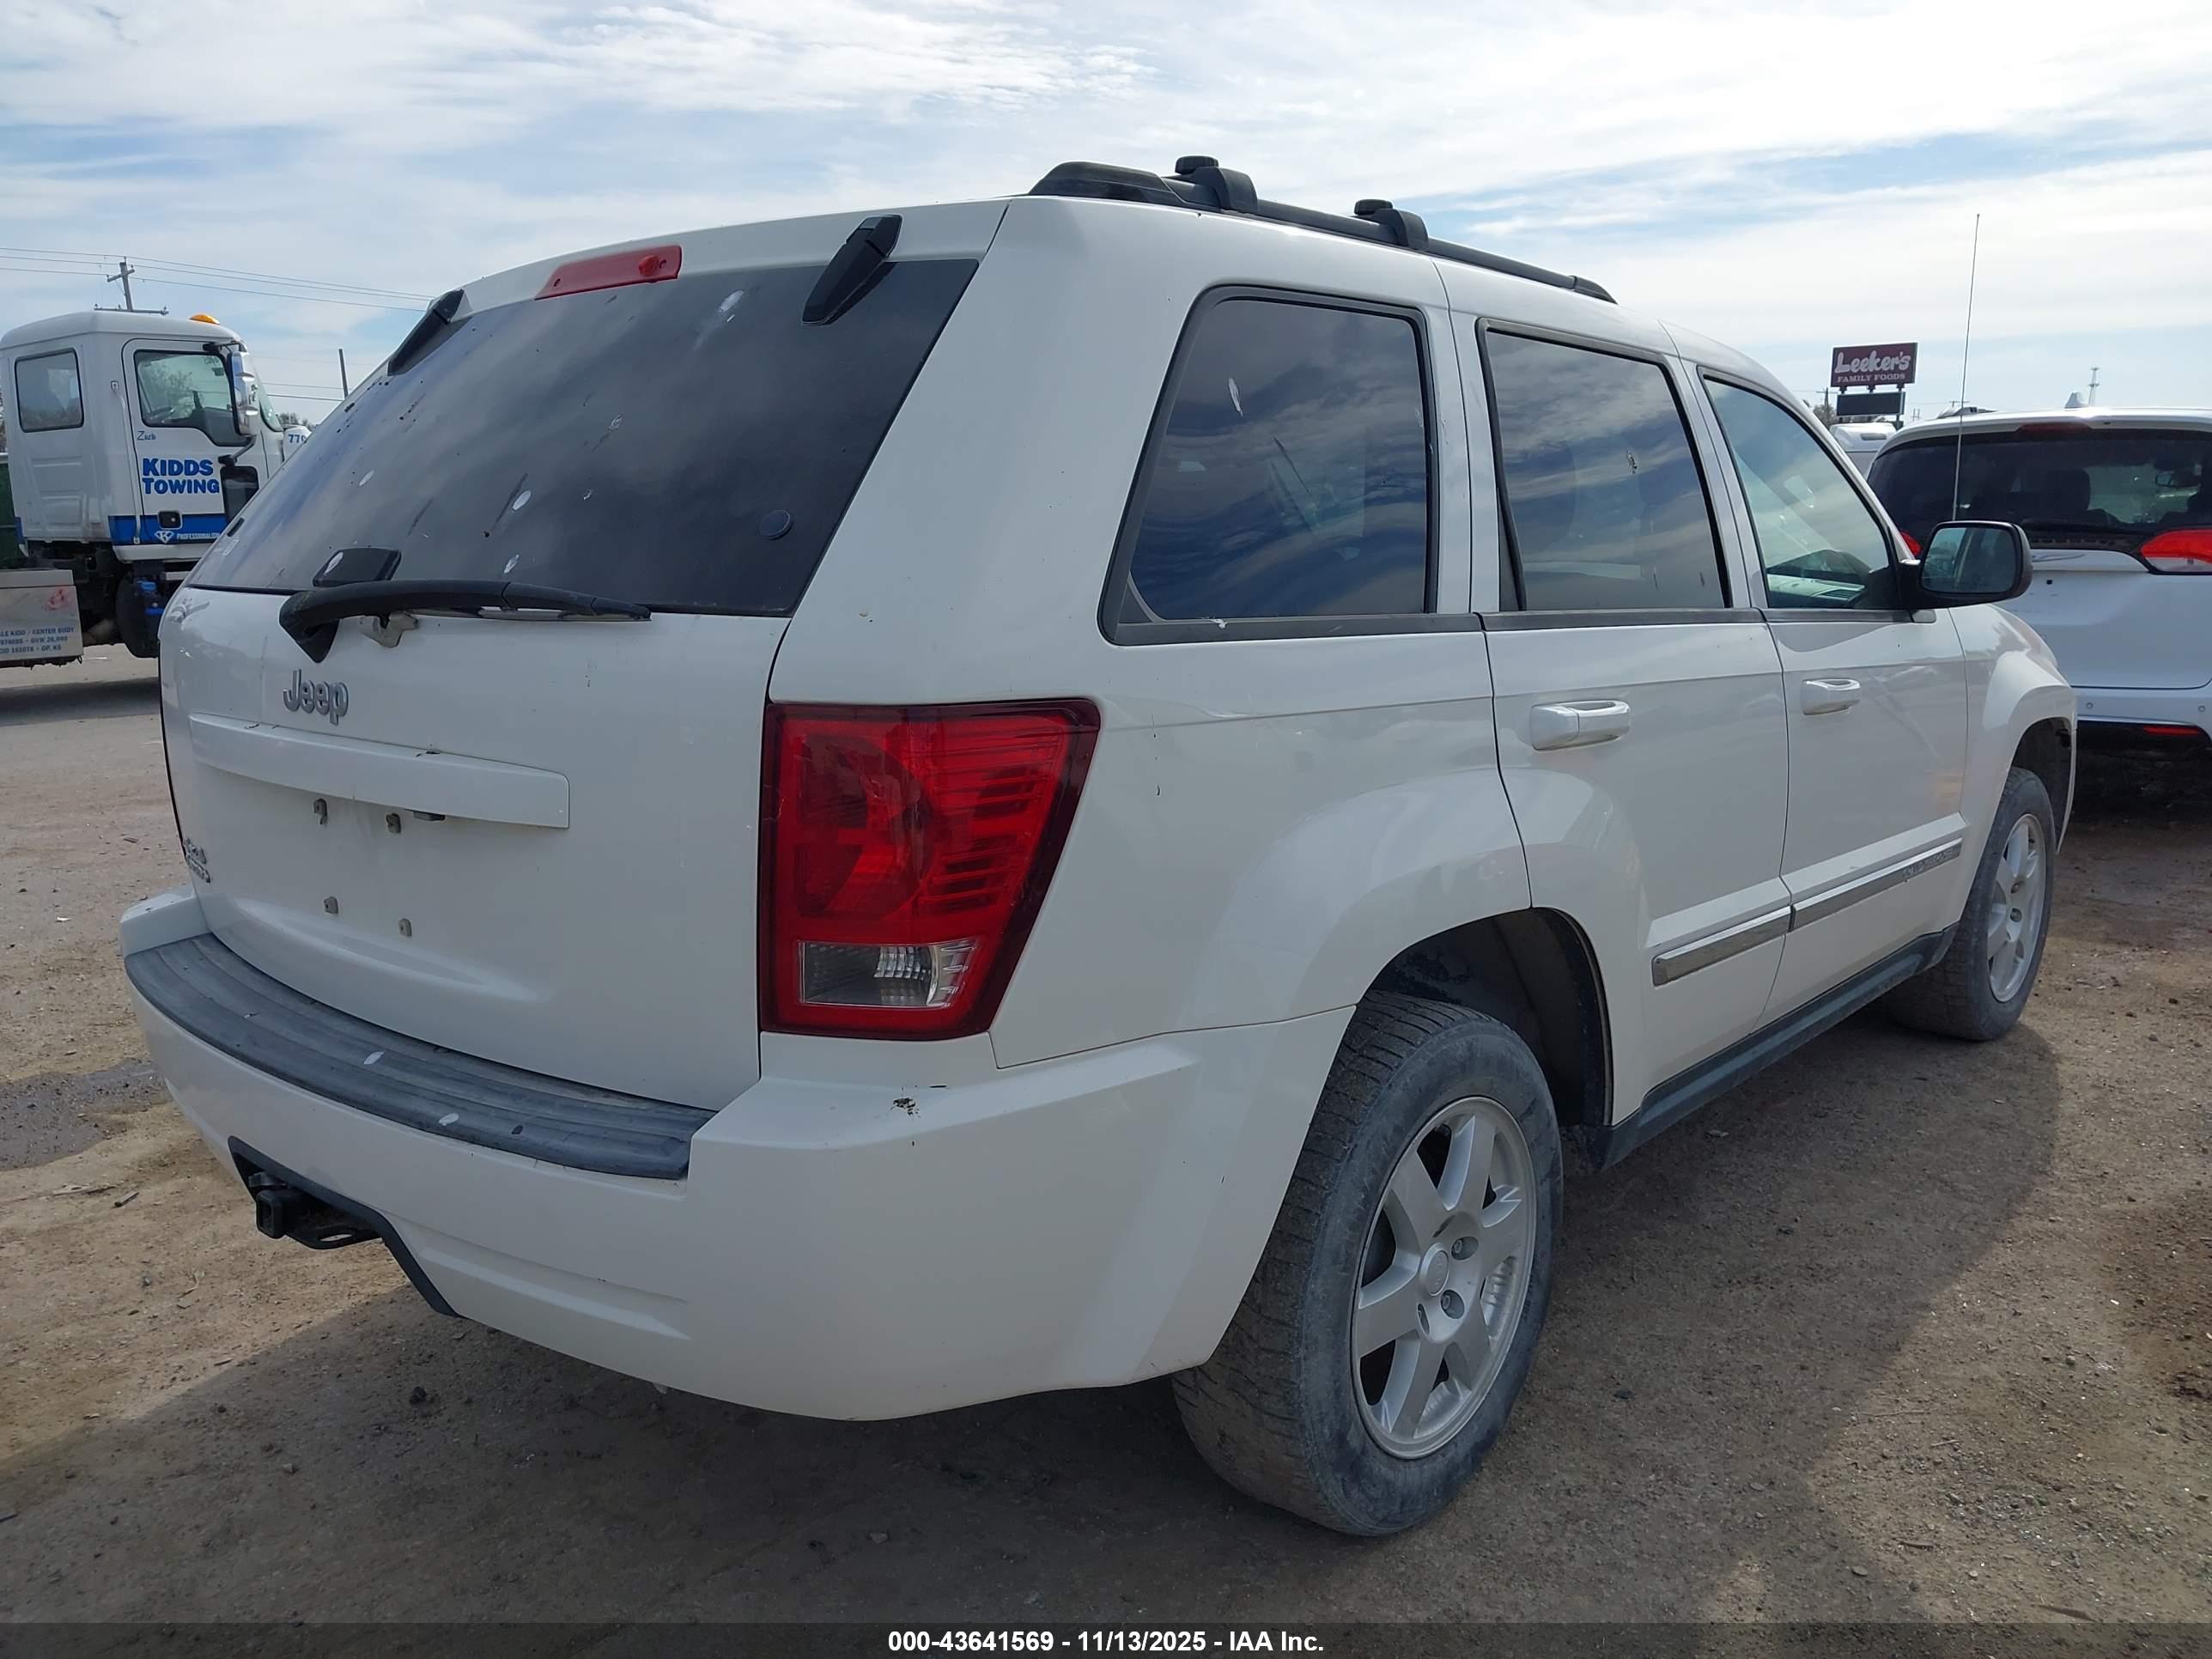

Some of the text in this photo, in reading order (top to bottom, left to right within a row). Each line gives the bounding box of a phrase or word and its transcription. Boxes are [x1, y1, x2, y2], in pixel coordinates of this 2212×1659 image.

[1834, 349, 1911, 374] Leeker's
[1837, 373, 1905, 383] FAMILY FOODS
[142, 458, 214, 477] KIDDS
[142, 477, 220, 495] TOWING
[283, 669, 349, 726] Jeep
